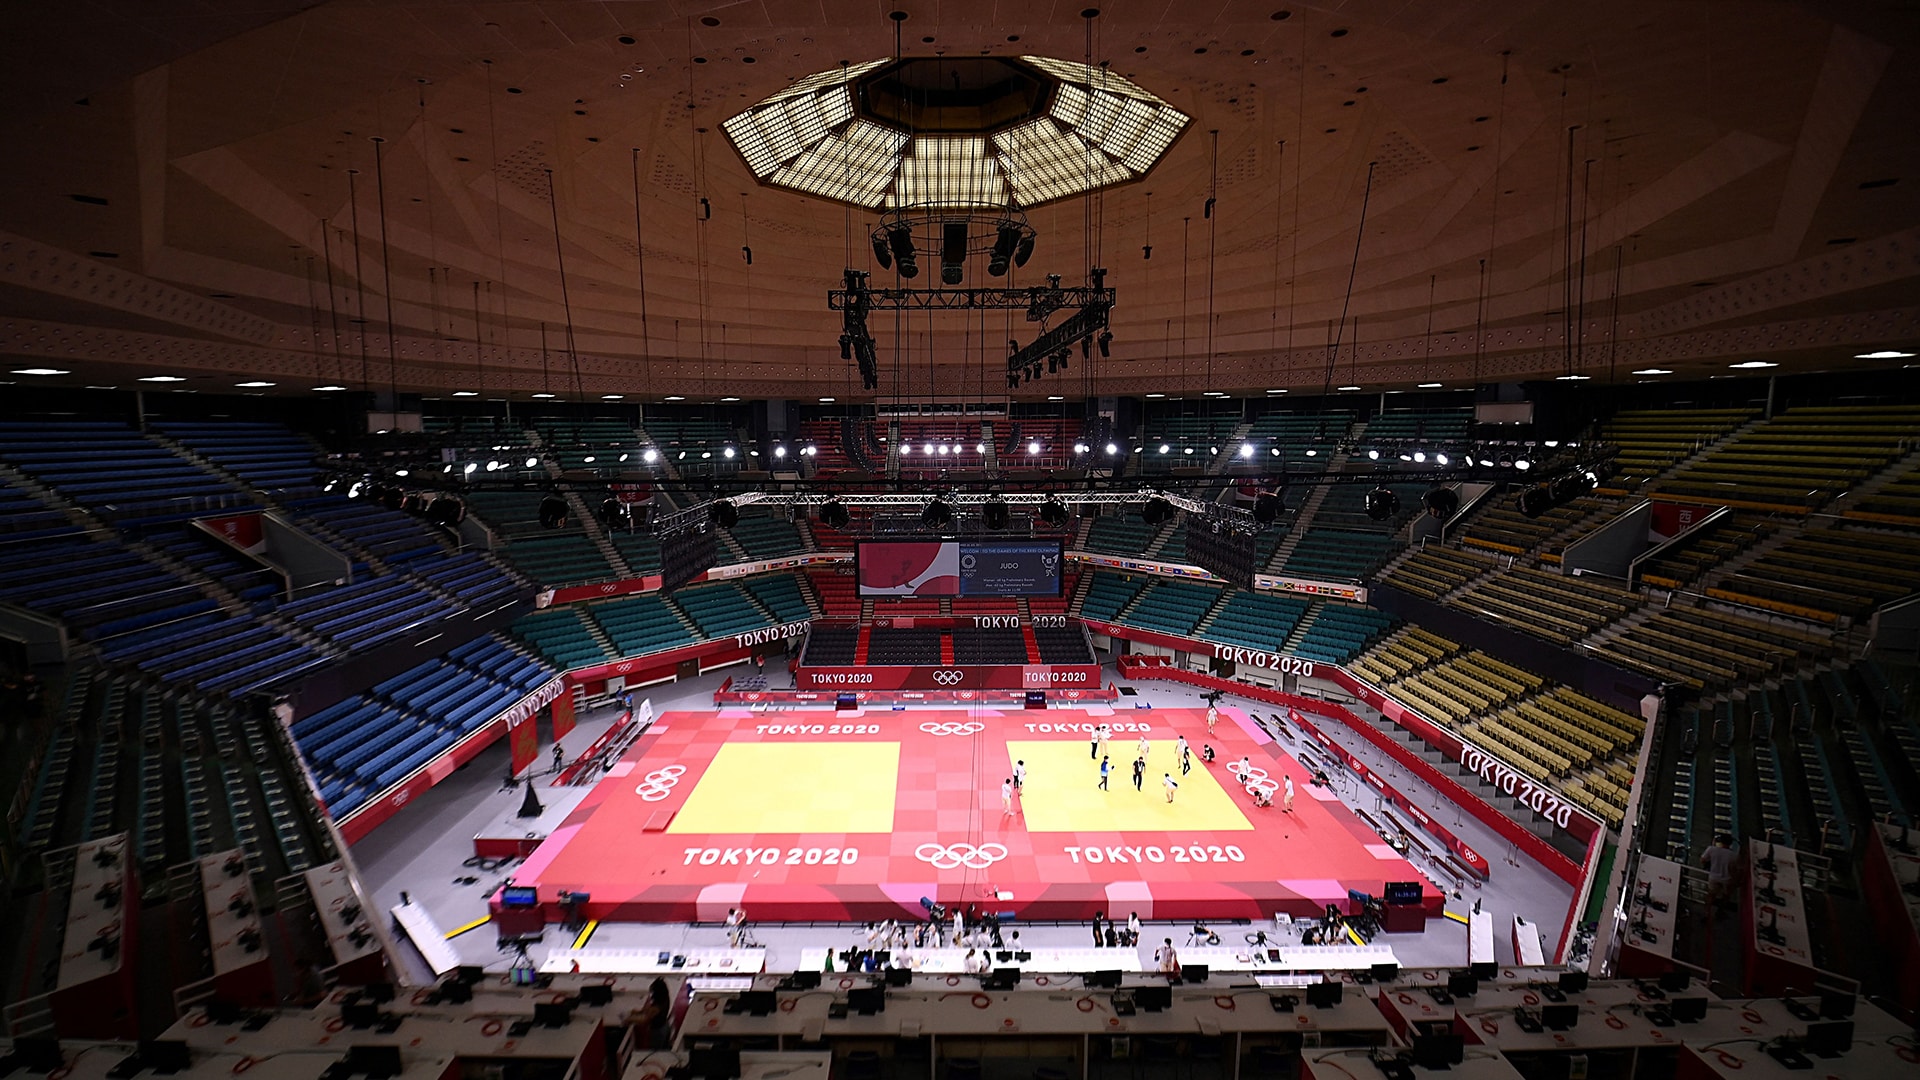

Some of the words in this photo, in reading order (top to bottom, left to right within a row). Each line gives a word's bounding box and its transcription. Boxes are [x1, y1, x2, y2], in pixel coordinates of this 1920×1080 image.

[973, 616, 1019, 629] TOKYO
[1033, 616, 1066, 628] 2020
[735, 626, 779, 648] TOKYO
[781, 620, 811, 640] 2020
[1214, 644, 1266, 668] TOKYO
[1270, 654, 1313, 677] 2020
[811, 674, 846, 684] TOKYO
[848, 673, 873, 684] 2020
[1025, 672, 1059, 682] TOKYO
[1061, 672, 1086, 682] 2020
[502, 697, 538, 732] TOKYO
[538, 679, 564, 708] 2020
[756, 724, 827, 735] TOKYO
[828, 724, 880, 735] 2020
[1024, 723, 1095, 733] TOKYO
[1460, 744, 1516, 795] TOKYO
[1518, 783, 1572, 829] 2020
[683, 848, 780, 866] TOKYO
[785, 848, 859, 866] 2020
[1064, 846, 1166, 864] TOKYO
[1170, 845, 1246, 864] 2020
